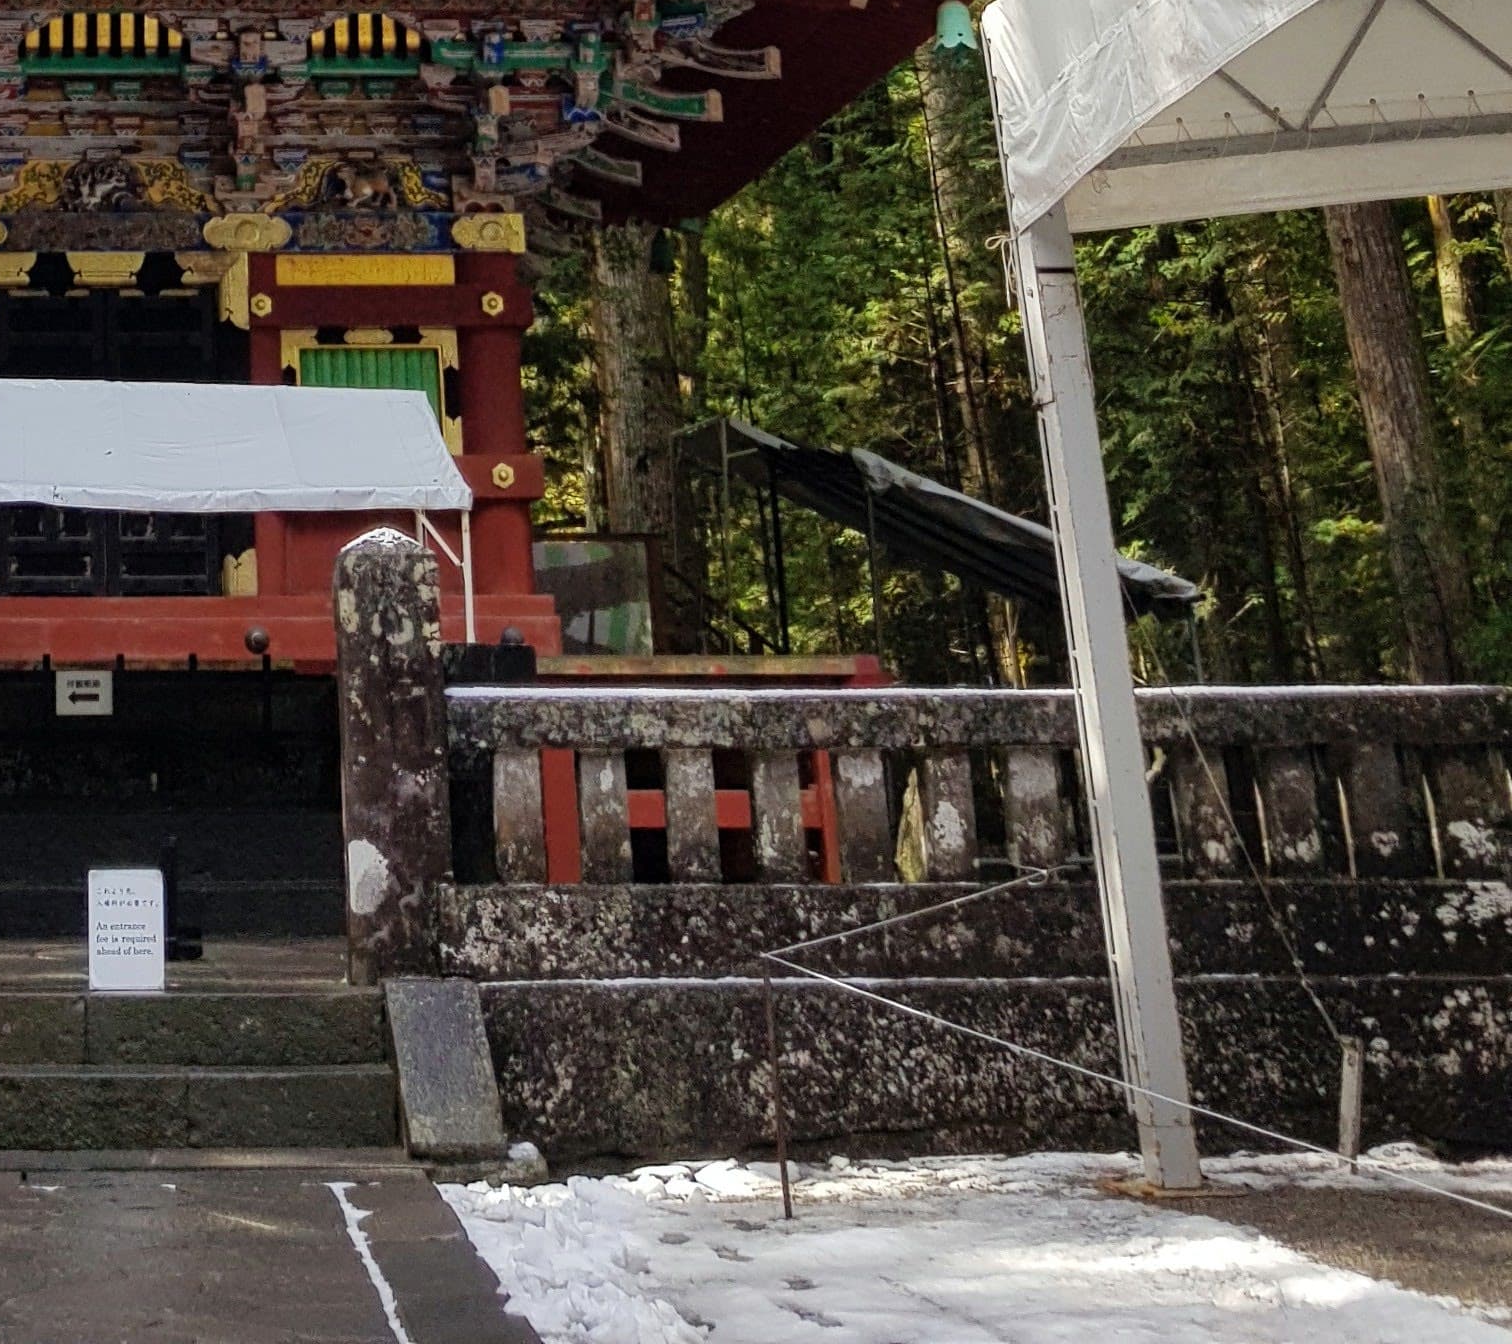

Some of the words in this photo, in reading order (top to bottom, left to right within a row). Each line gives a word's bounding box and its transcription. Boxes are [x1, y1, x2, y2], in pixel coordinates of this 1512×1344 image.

[96, 921, 108, 930] An
[110, 922, 146, 930] entrance
[96, 935, 108, 943] fee
[111, 935, 119, 943] is
[121, 935, 157, 945] required
[96, 946, 121, 956] ahead
[123, 946, 132, 956] of
[133, 946, 154, 956] here.
